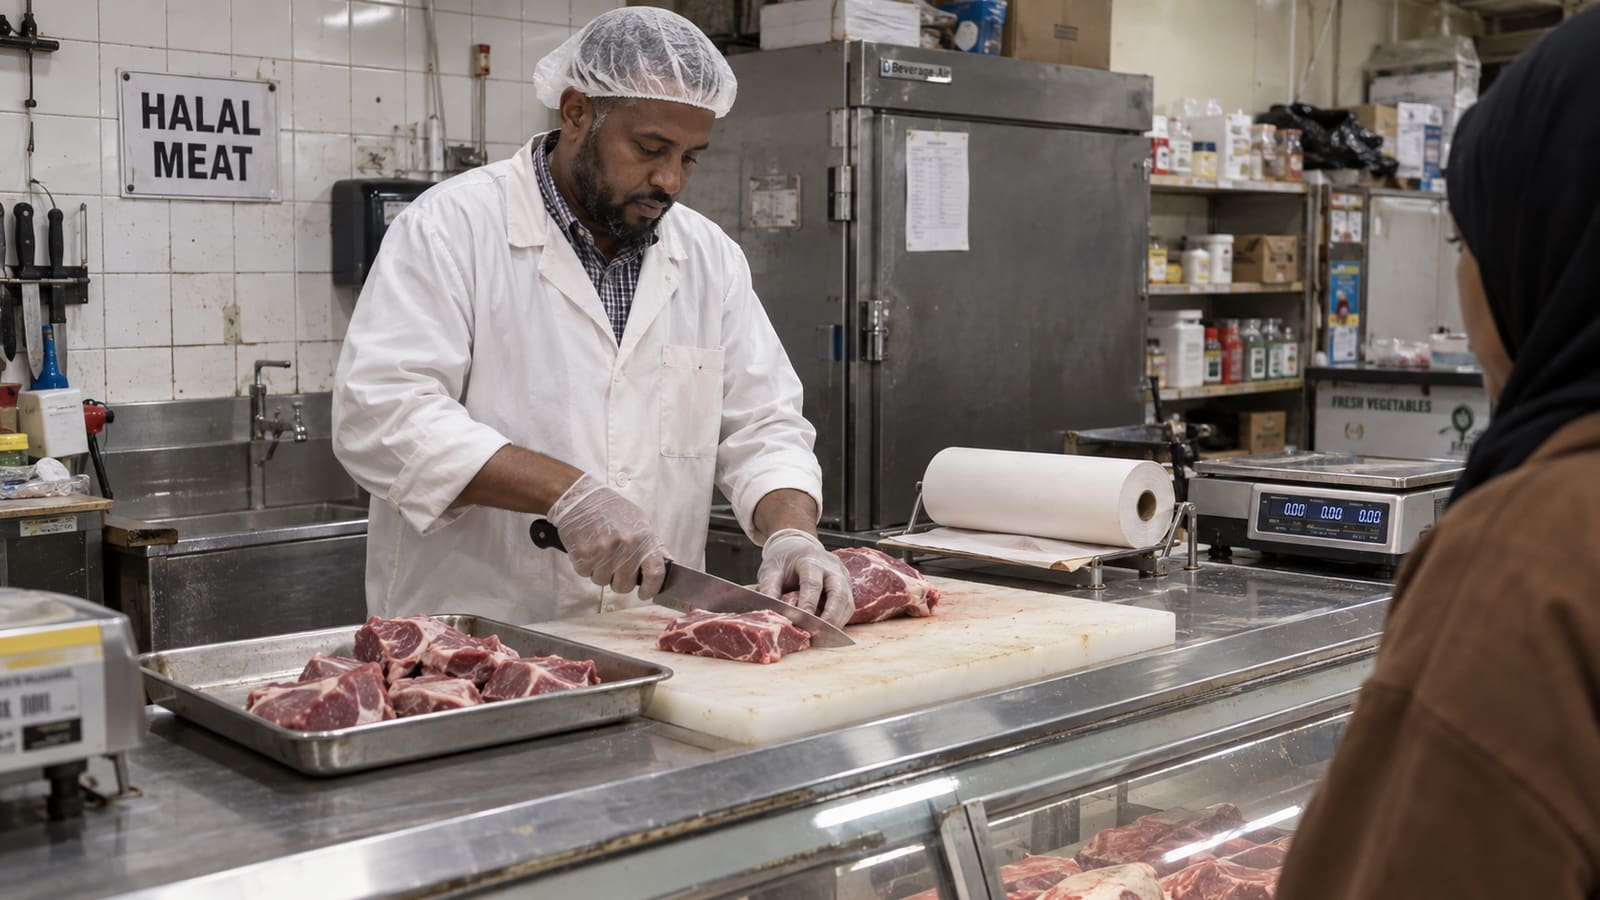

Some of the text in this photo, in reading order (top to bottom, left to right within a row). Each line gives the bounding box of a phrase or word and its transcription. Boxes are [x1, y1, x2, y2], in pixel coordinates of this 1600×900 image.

[141, 92, 261, 136] HALAL
[153, 141, 253, 181] MEAT
[1332, 395, 1432, 413] FRESH VEGETABLES
[1284, 502, 1382, 524] 0.00 0.00 0.00
